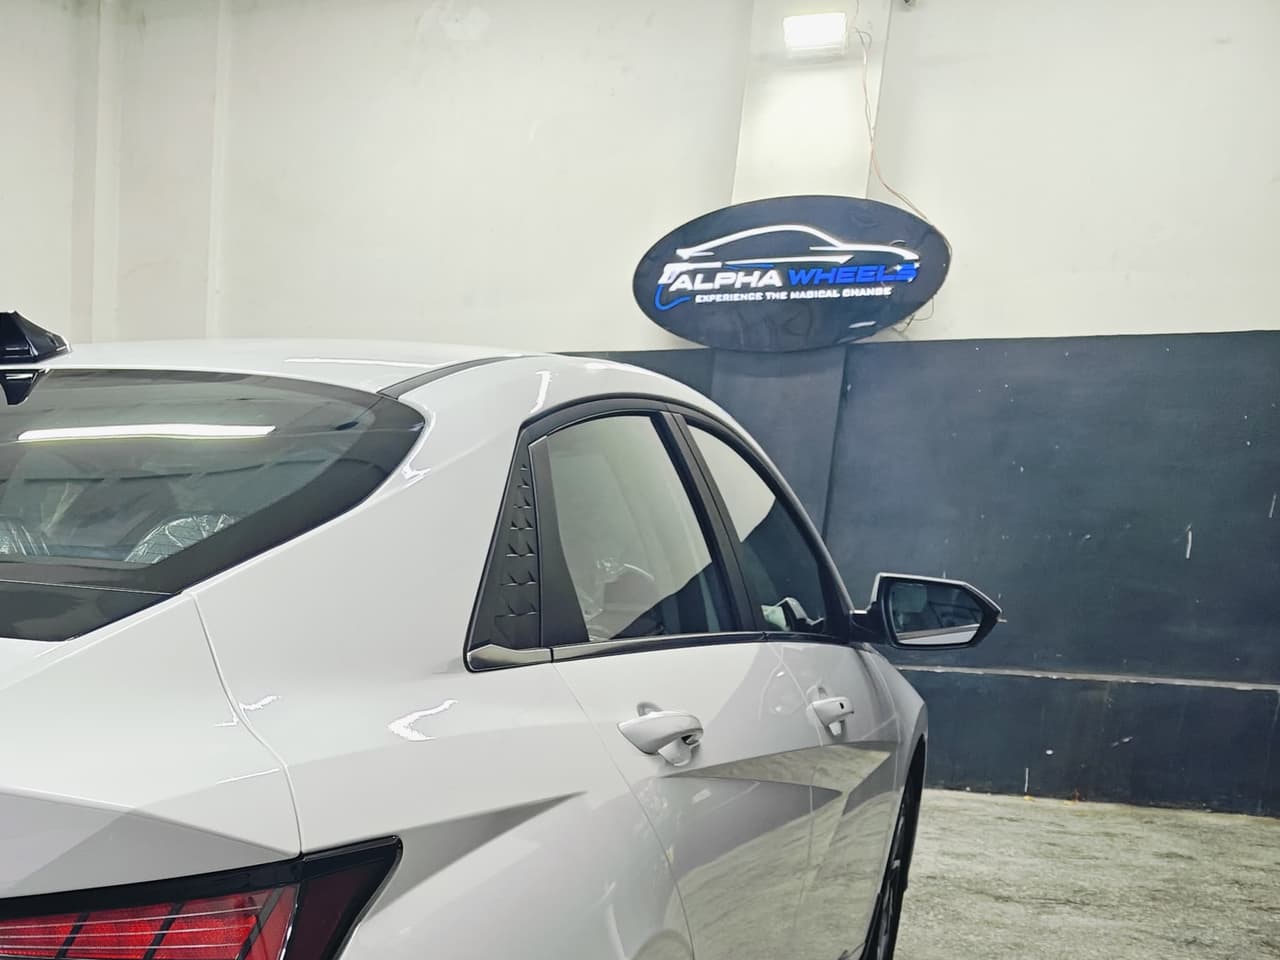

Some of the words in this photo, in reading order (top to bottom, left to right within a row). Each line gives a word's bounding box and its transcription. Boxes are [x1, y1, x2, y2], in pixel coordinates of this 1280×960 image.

[669, 269, 783, 291] ALPHA
[788, 262, 919, 286] WHEELS
[695, 292, 763, 304] EXPERIENCE
[765, 291, 788, 301] THE
[790, 289, 840, 299] MAGICAL
[842, 286, 892, 298] CHANGE
